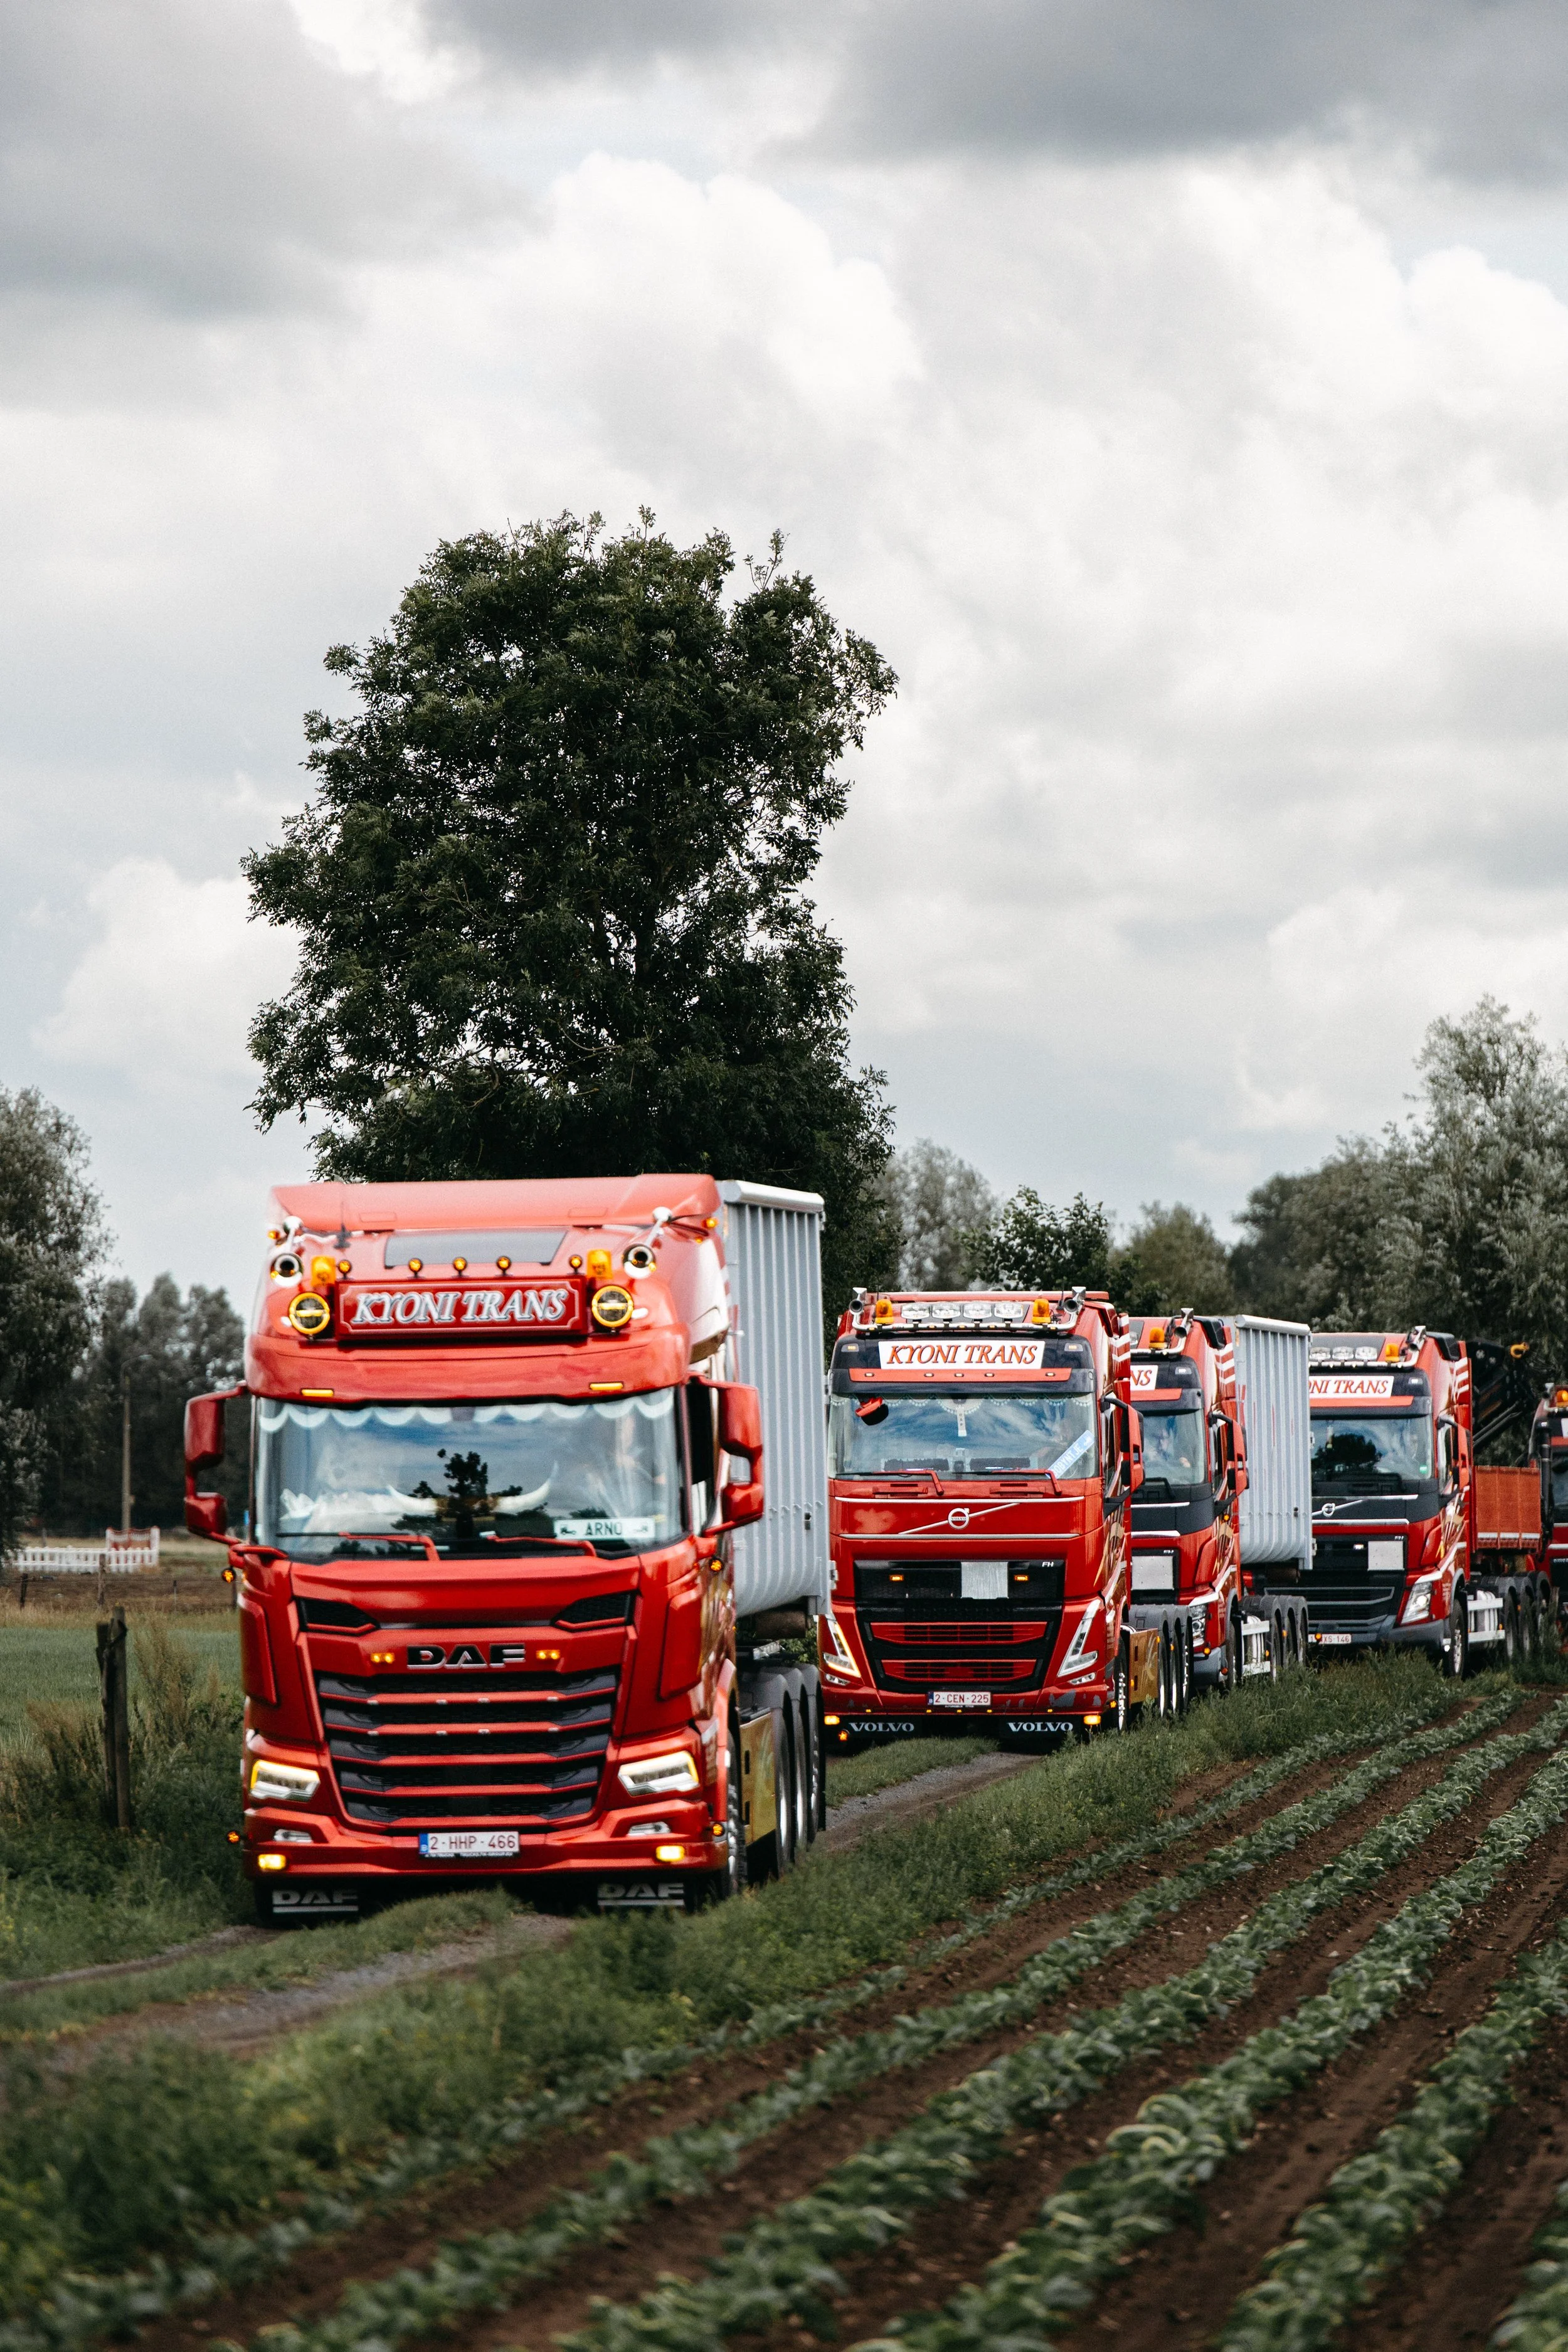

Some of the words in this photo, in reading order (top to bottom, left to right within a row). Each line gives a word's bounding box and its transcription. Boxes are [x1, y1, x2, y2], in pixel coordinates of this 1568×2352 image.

[351, 1291, 462, 1325] KYONI
[460, 1289, 568, 1323] TRANS
[887, 1345, 961, 1364] KYONI
[965, 1344, 1037, 1364] TRANS
[1334, 1379, 1388, 1394] TRANS
[585, 1522, 622, 1536] ARNO
[407, 1643, 526, 1670] DAF
[849, 1722, 914, 1732] VOLVO
[1008, 1722, 1073, 1732] VOLVO
[272, 1890, 358, 1904] DAF
[597, 1882, 684, 1898] DAF
